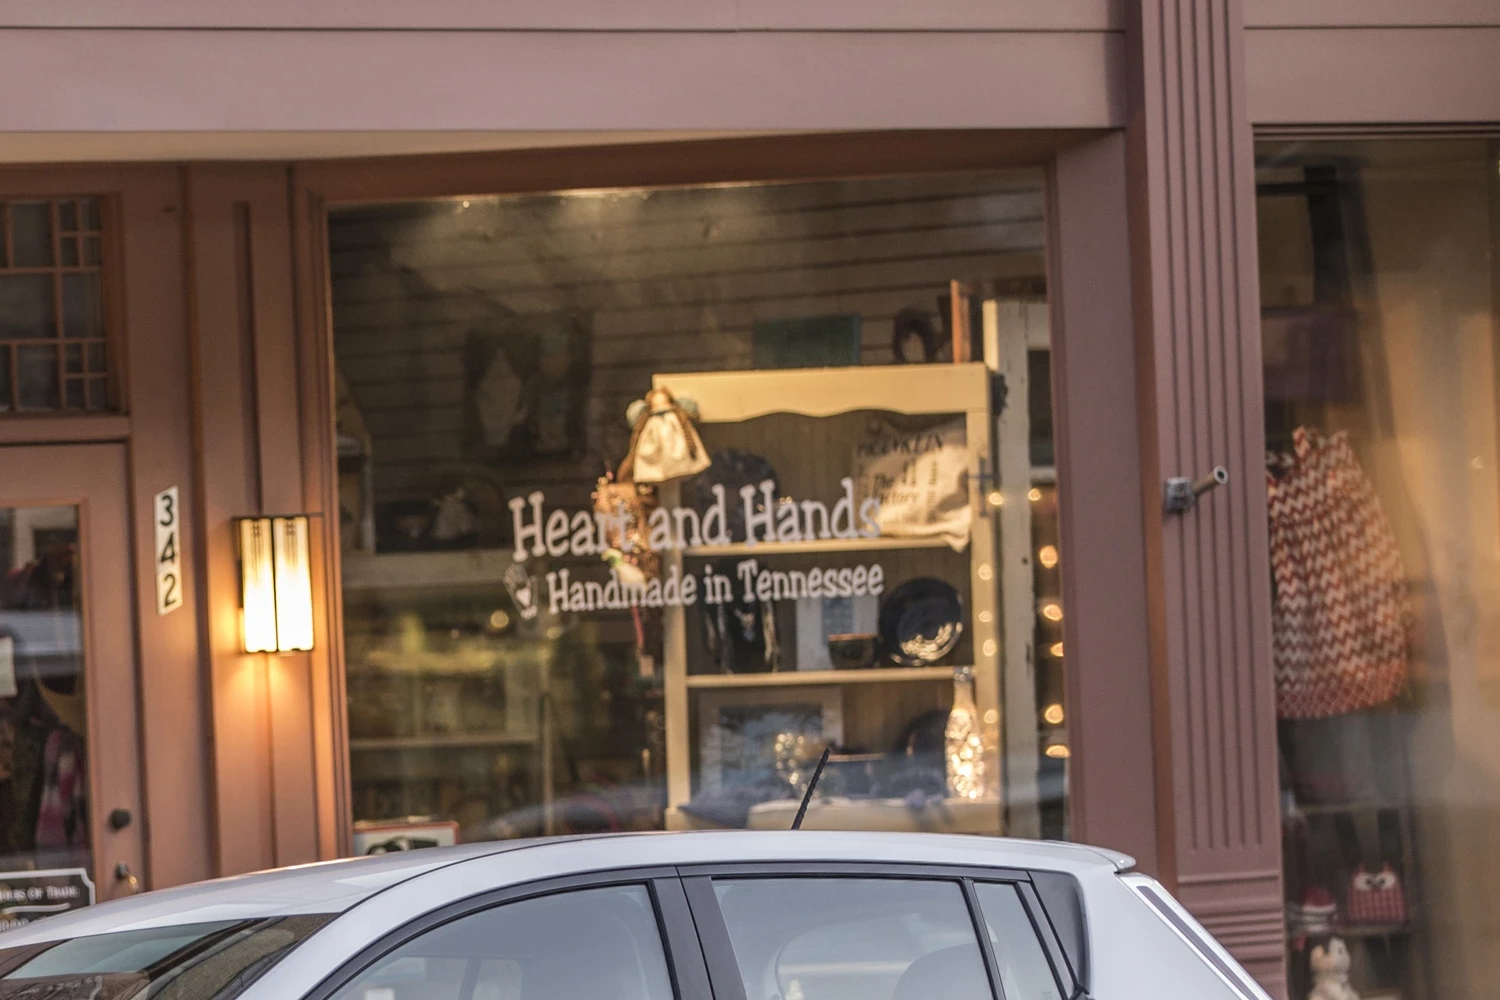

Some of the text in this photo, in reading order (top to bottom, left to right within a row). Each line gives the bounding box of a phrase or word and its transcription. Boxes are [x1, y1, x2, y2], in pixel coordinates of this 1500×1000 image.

[160, 494, 176, 608] 342
[508, 491, 633, 562] Heart
[649, 483, 731, 549] and
[739, 477, 882, 547] Hands
[546, 559, 885, 615] Handmade in Tennessee
